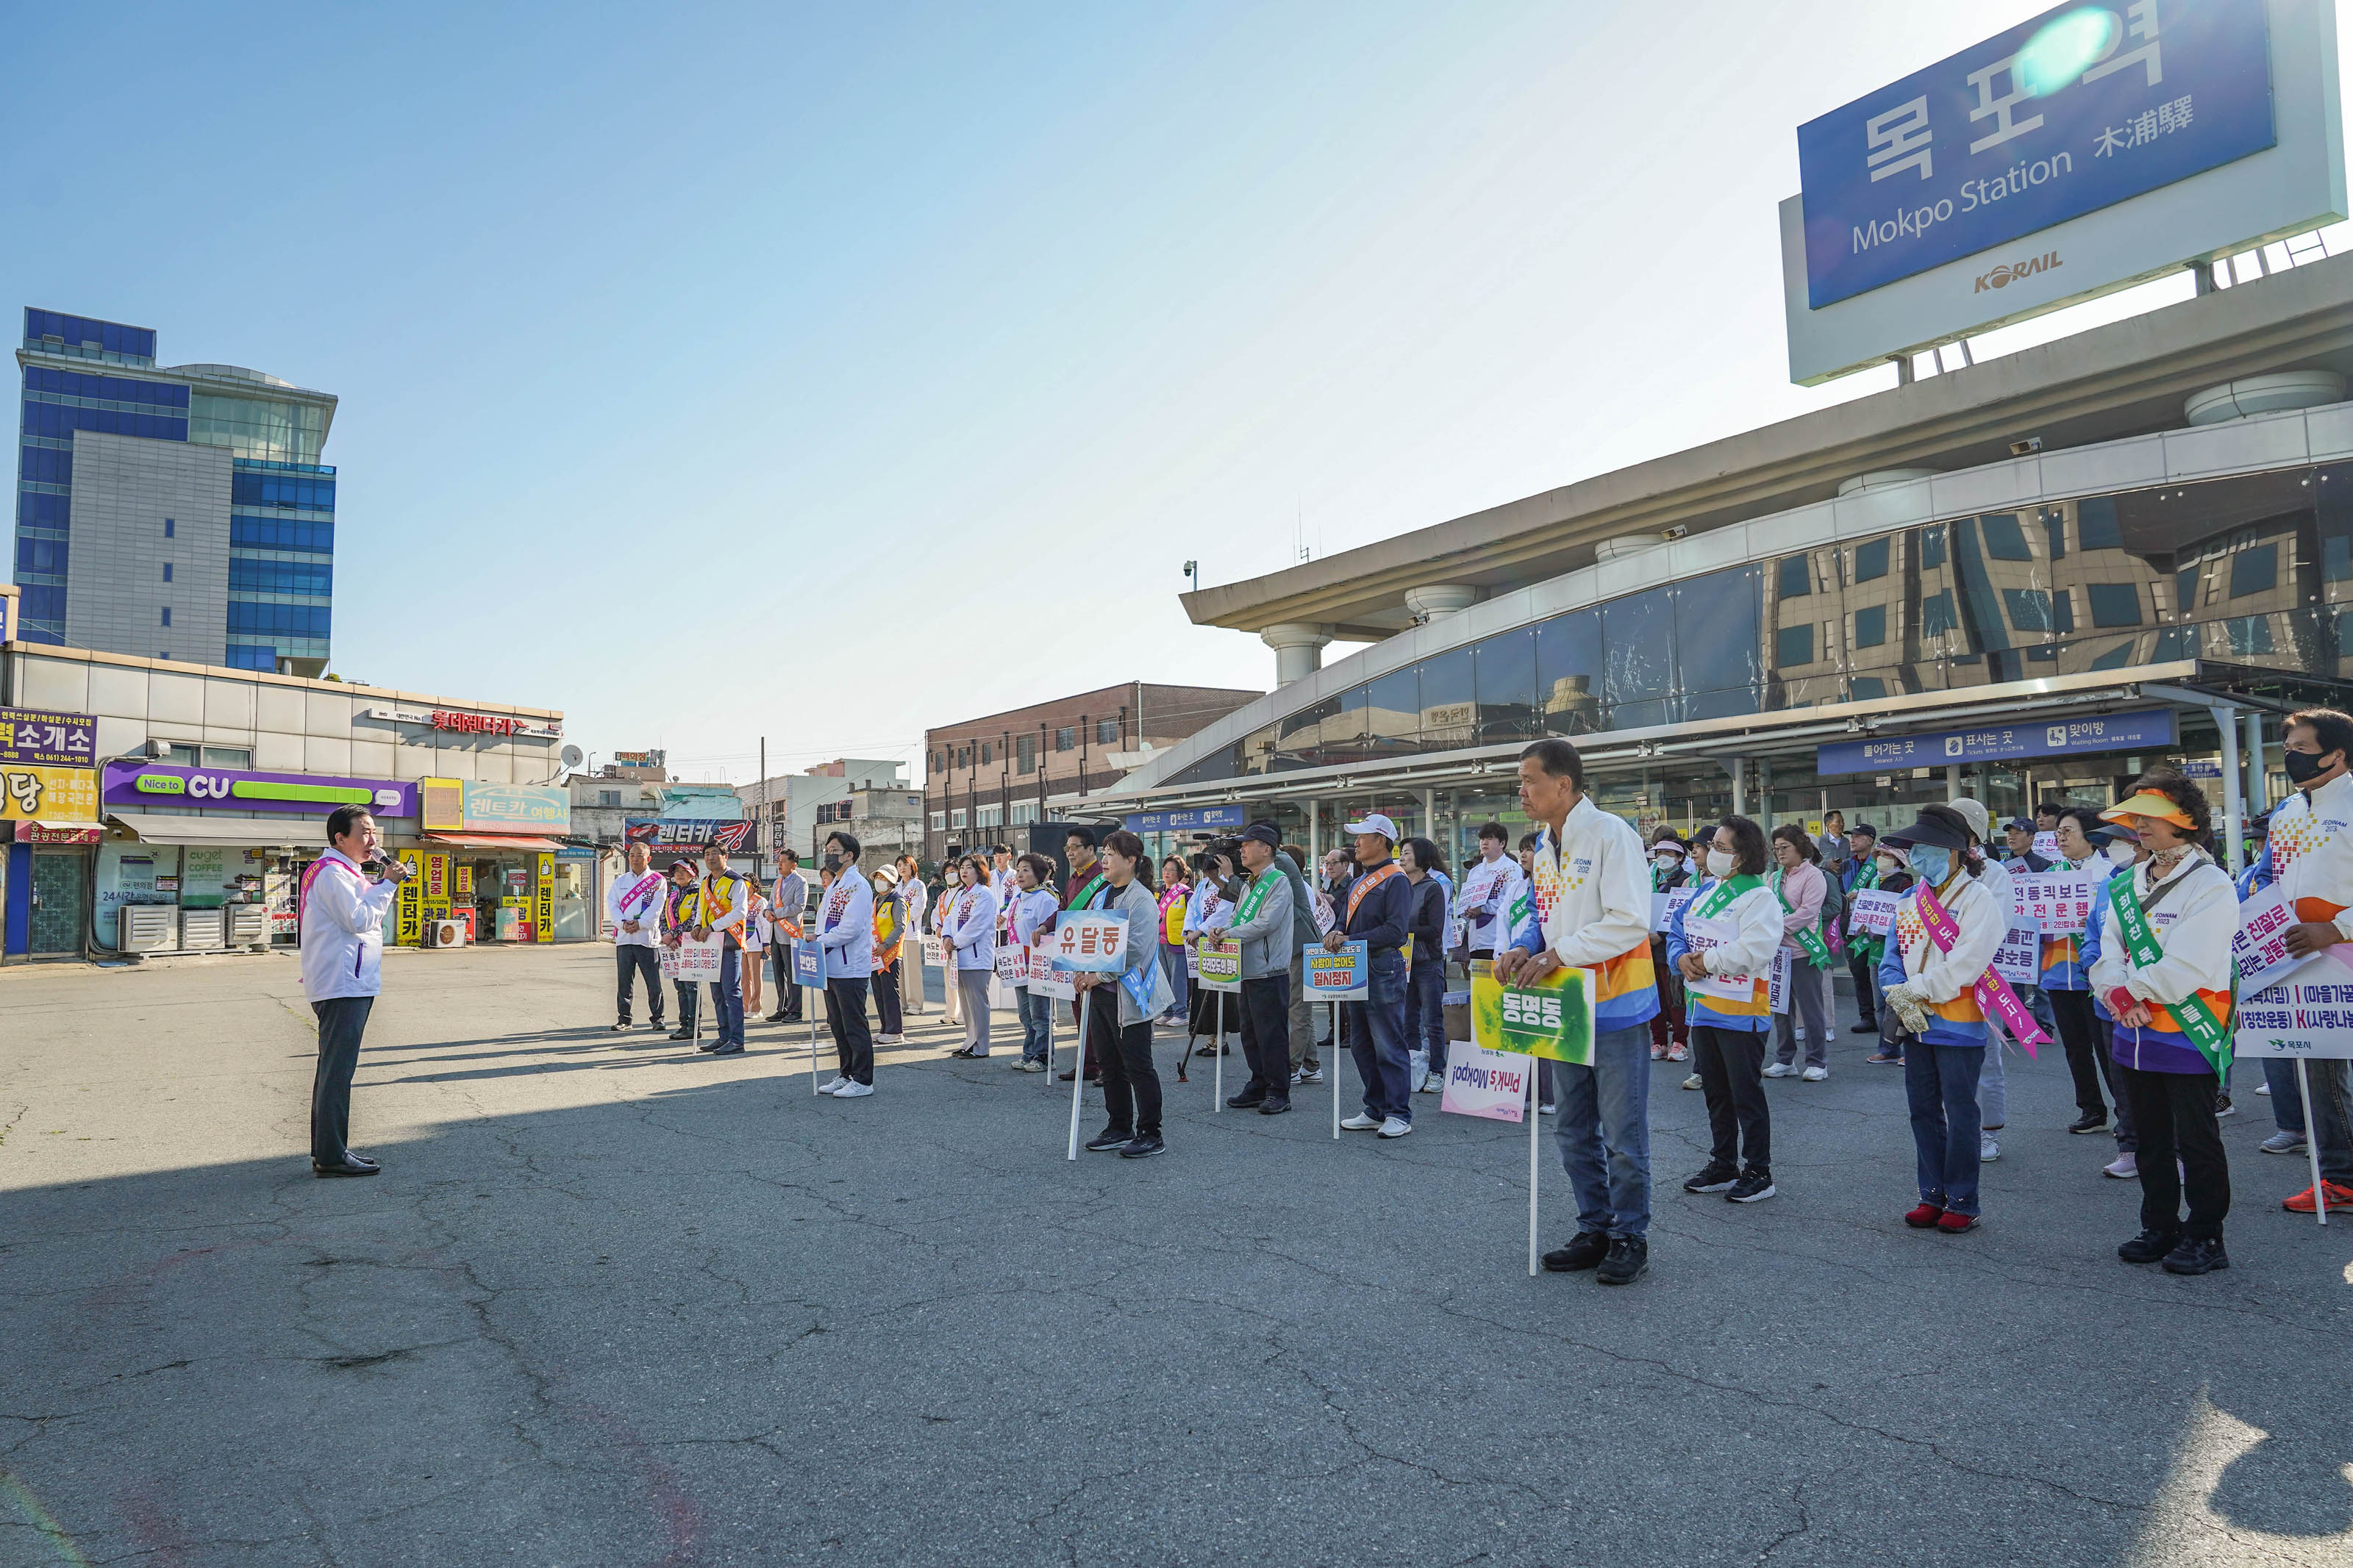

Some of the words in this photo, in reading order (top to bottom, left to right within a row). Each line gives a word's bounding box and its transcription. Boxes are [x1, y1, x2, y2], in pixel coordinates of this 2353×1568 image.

[1865, 0, 2163, 182] 목포역
[2093, 94, 2194, 158] 木浦驛
[1852, 198, 1954, 254] Mokpo
[1960, 151, 2073, 212] Station
[1974, 250, 2063, 294] KORAIL
[432, 710, 511, 737] 롯데렌터카
[1864, 742, 1902, 757] 들어가는
[1905, 740, 1914, 753] 곳
[1966, 733, 1997, 745] 표사는
[2002, 731, 2013, 744] 곳
[2069, 721, 2105, 737] 맞이방
[2071, 739, 2091, 747] Waiting
[60, 754, 89, 763] 244-1010
[144, 779, 166, 789] Nice
[168, 781, 179, 790] to
[188, 775, 229, 799] CU
[471, 798, 526, 817] 렌트카
[531, 806, 567, 821] 여행사
[658, 824, 713, 843] 렌터카
[714, 820, 753, 851] 킹
[774, 824, 783, 847] 렌터카
[189, 864, 223, 872] COFFEE
[430, 856, 443, 895] 영업중
[460, 868, 468, 891] 영업중
[103, 891, 134, 901] 24시간
[133, 881, 153, 889] 편의점
[402, 887, 418, 936] 렌터카
[540, 887, 551, 932] 렌터카
[1873, 901, 1881, 912] 말
[2118, 892, 2143, 941] 희망찬
[2246, 903, 2290, 942] 친절로
[926, 942, 940, 950] 속도는
[1060, 926, 1120, 956] 유달동
[998, 956, 1012, 967] 속도는
[1032, 954, 1043, 967] 안전한
[1310, 957, 1332, 969] 사람이
[1333, 956, 1356, 969] 없어도
[999, 968, 1015, 981] 안전은
[1313, 971, 1352, 987] 일시정지
[1769, 983, 1781, 1008] 한마디
[1502, 992, 1562, 1028] 동명동
[1998, 992, 2024, 1028] 도시!
[2179, 1003, 2216, 1039] 들기
[2288, 1040, 2311, 1050] 목포시
[1452, 1062, 1488, 1089] Mokpo!
[1490, 1070, 1521, 1093] Pink's
